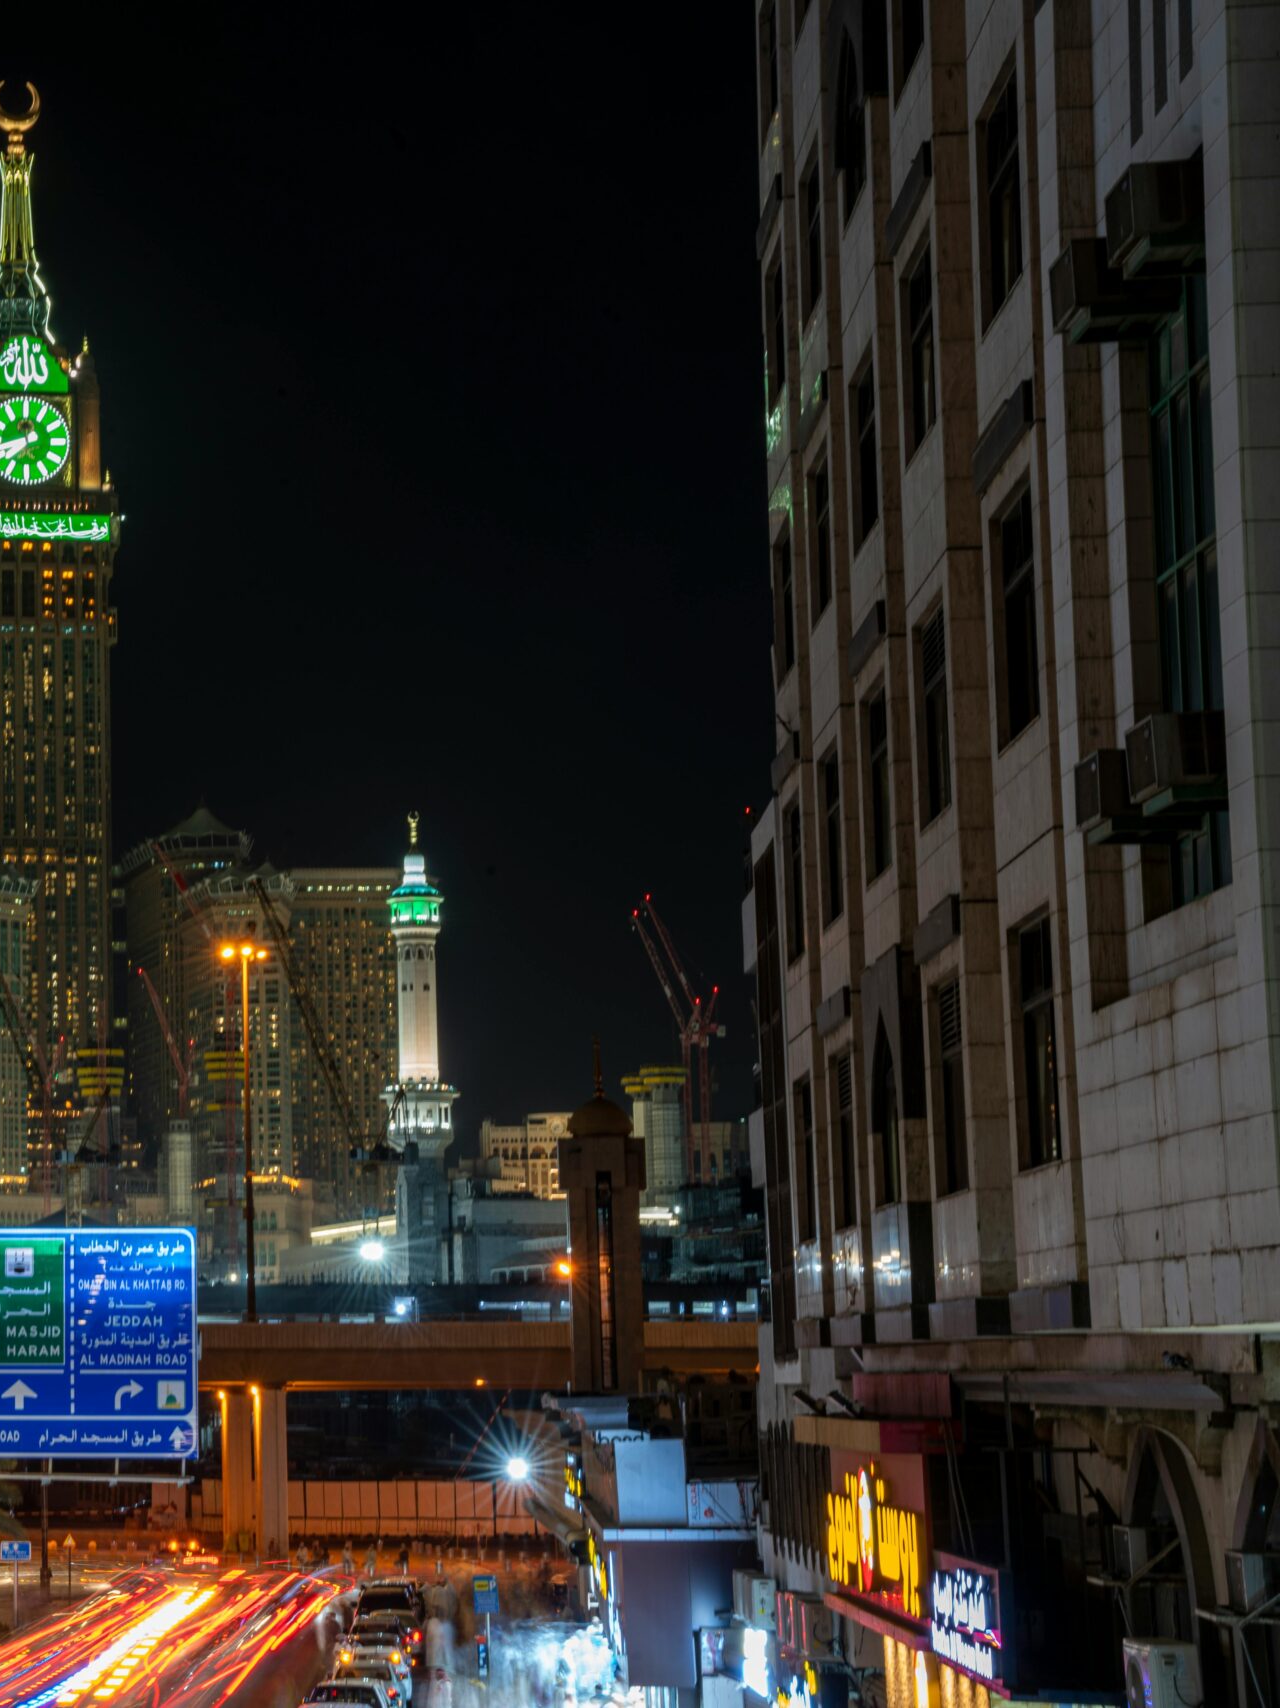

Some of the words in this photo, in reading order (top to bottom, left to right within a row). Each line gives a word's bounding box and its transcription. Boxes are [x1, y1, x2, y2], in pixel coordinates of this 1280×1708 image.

[79, 1239, 120, 1255] الخطاب
[121, 1241, 134, 1257] بن
[135, 1242, 155, 1257] عمر
[156, 1239, 186, 1258] طريق
[104, 1278, 117, 1291] BIN
[119, 1279, 131, 1291] AL
[132, 1279, 173, 1292] KHATTAB
[107, 1296, 157, 1312] جدة
[103, 1314, 164, 1328] JEDDAH
[6, 1325, 62, 1338] MASJID
[81, 1331, 117, 1349] المنورة
[120, 1332, 155, 1349] المدينة
[156, 1332, 188, 1350] طريق
[6, 1344, 61, 1358] HARAM
[79, 1353, 95, 1366] AL
[99, 1353, 151, 1366] MADINAH
[155, 1353, 188, 1366] ROAD
[38, 1428, 78, 1448] الحرام
[79, 1428, 128, 1447] المسجد
[130, 1428, 163, 1448] طريق
